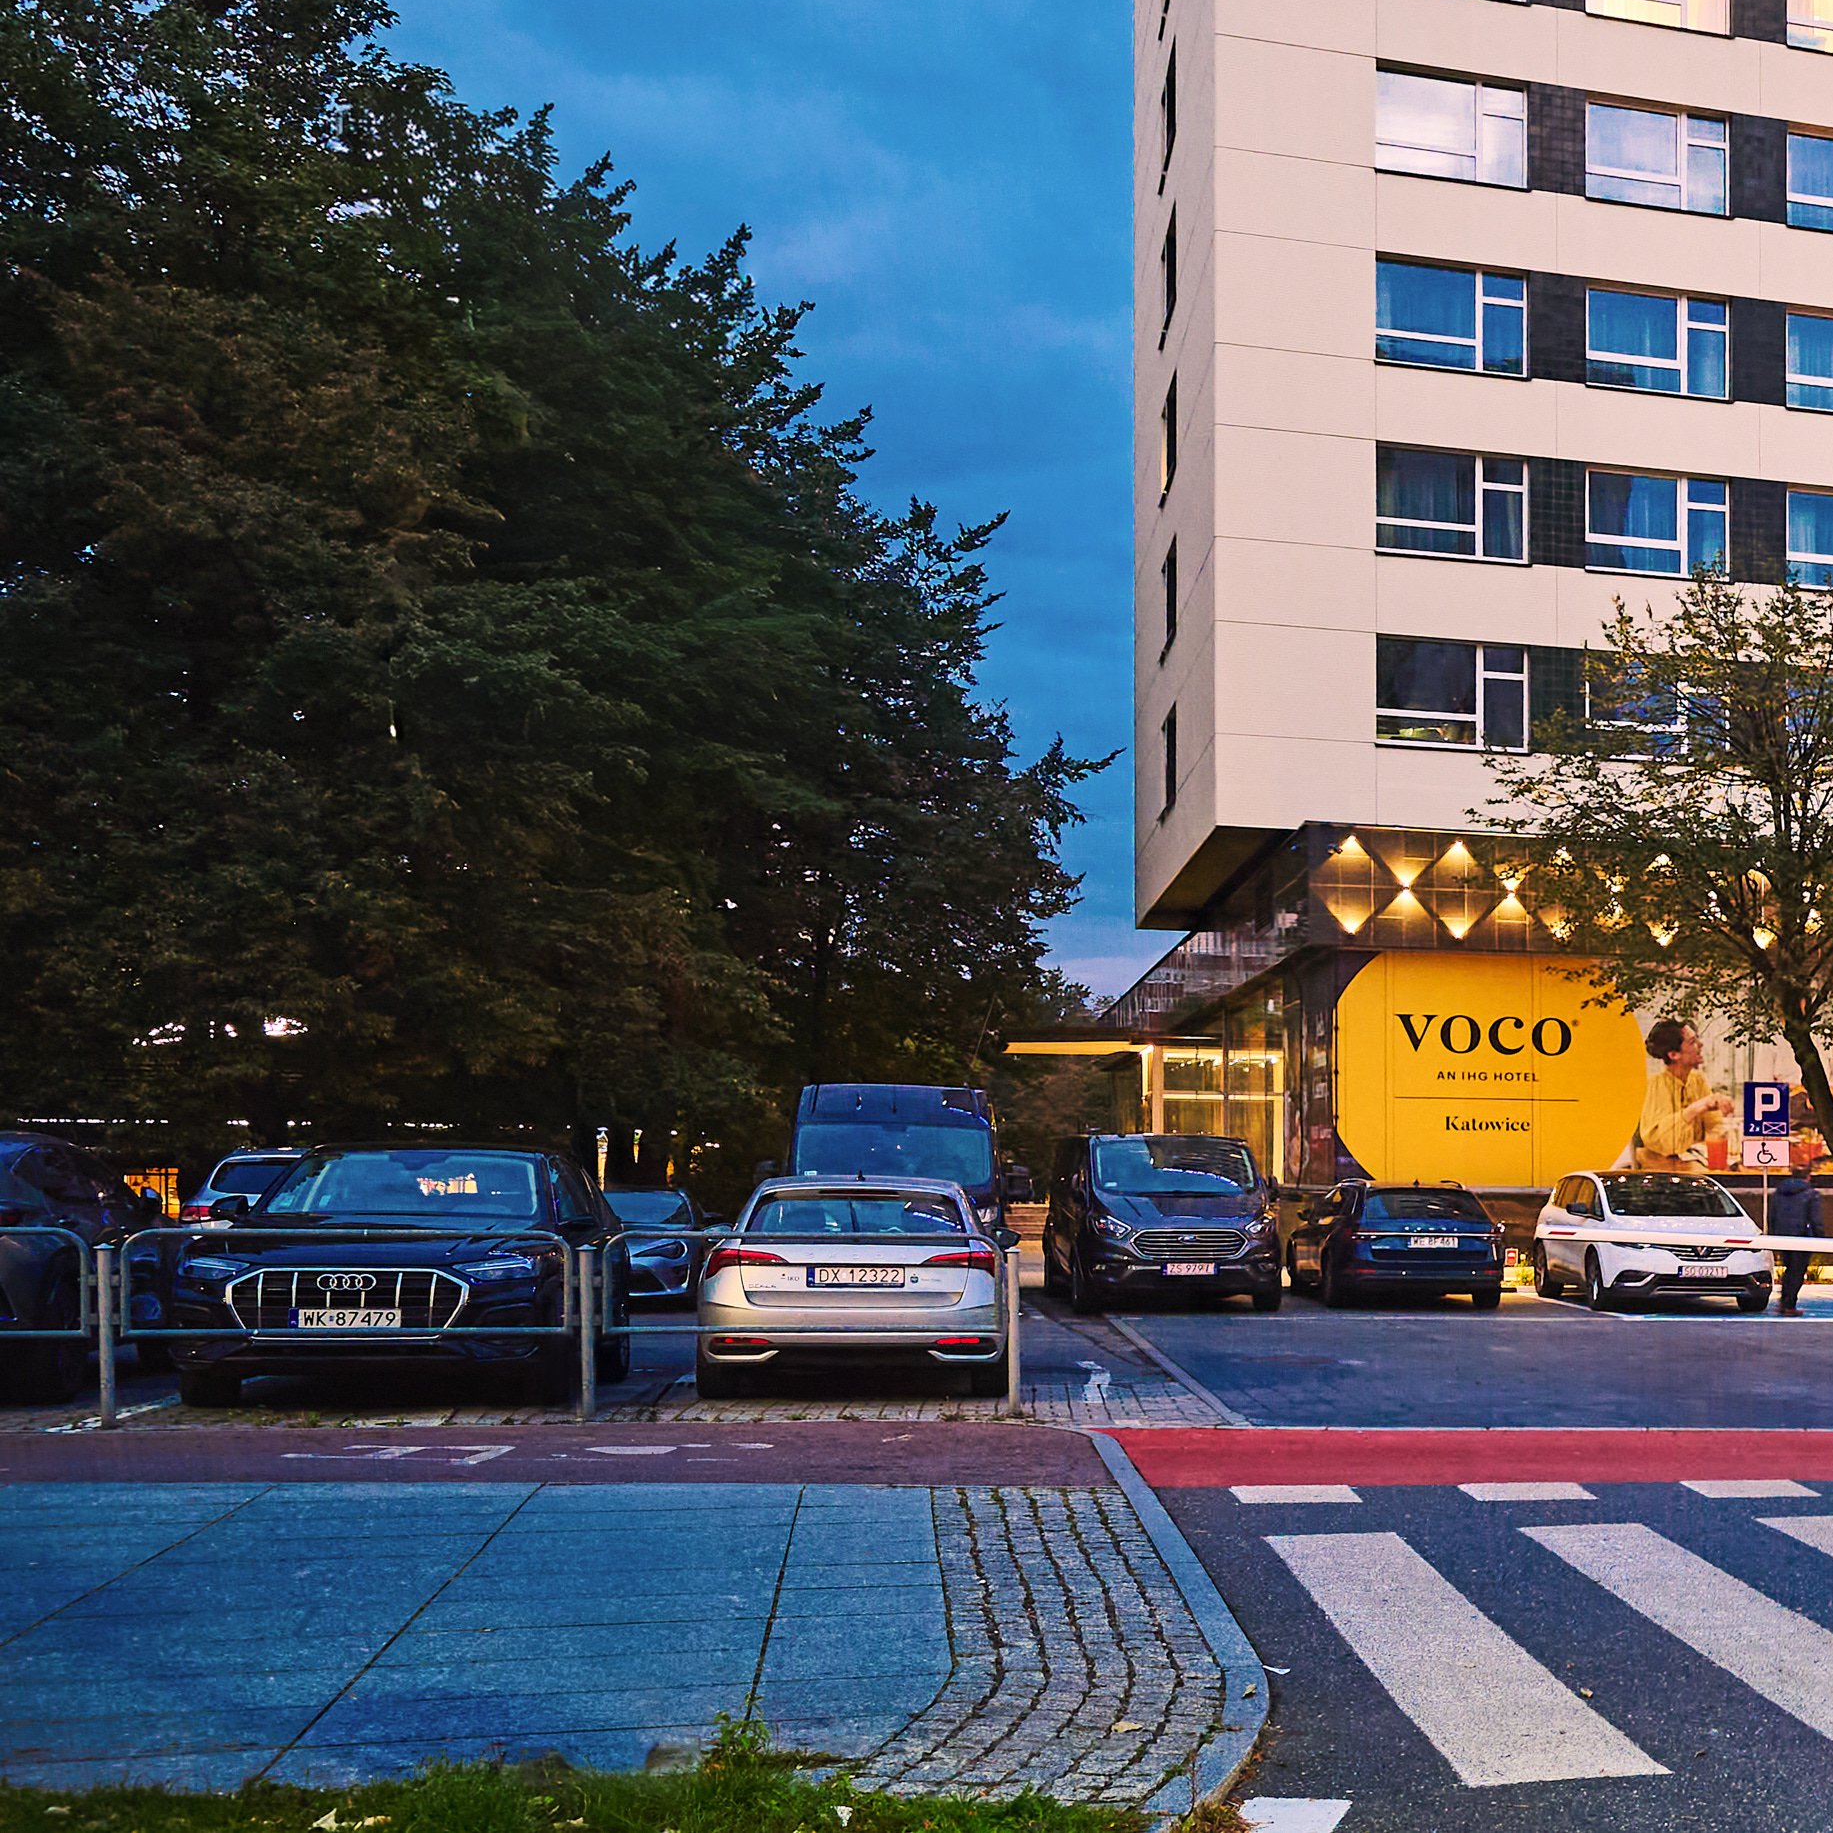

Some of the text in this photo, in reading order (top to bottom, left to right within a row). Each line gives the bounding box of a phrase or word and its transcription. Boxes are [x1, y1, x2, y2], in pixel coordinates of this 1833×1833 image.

[1437, 1071, 1540, 1083] AN IHG HOTEL
[1754, 1087, 1780, 1120] P
[1445, 1116, 1531, 1132] Katowice
[819, 1268, 900, 1283] DX 12322
[303, 1311, 396, 1327] WK 87479
